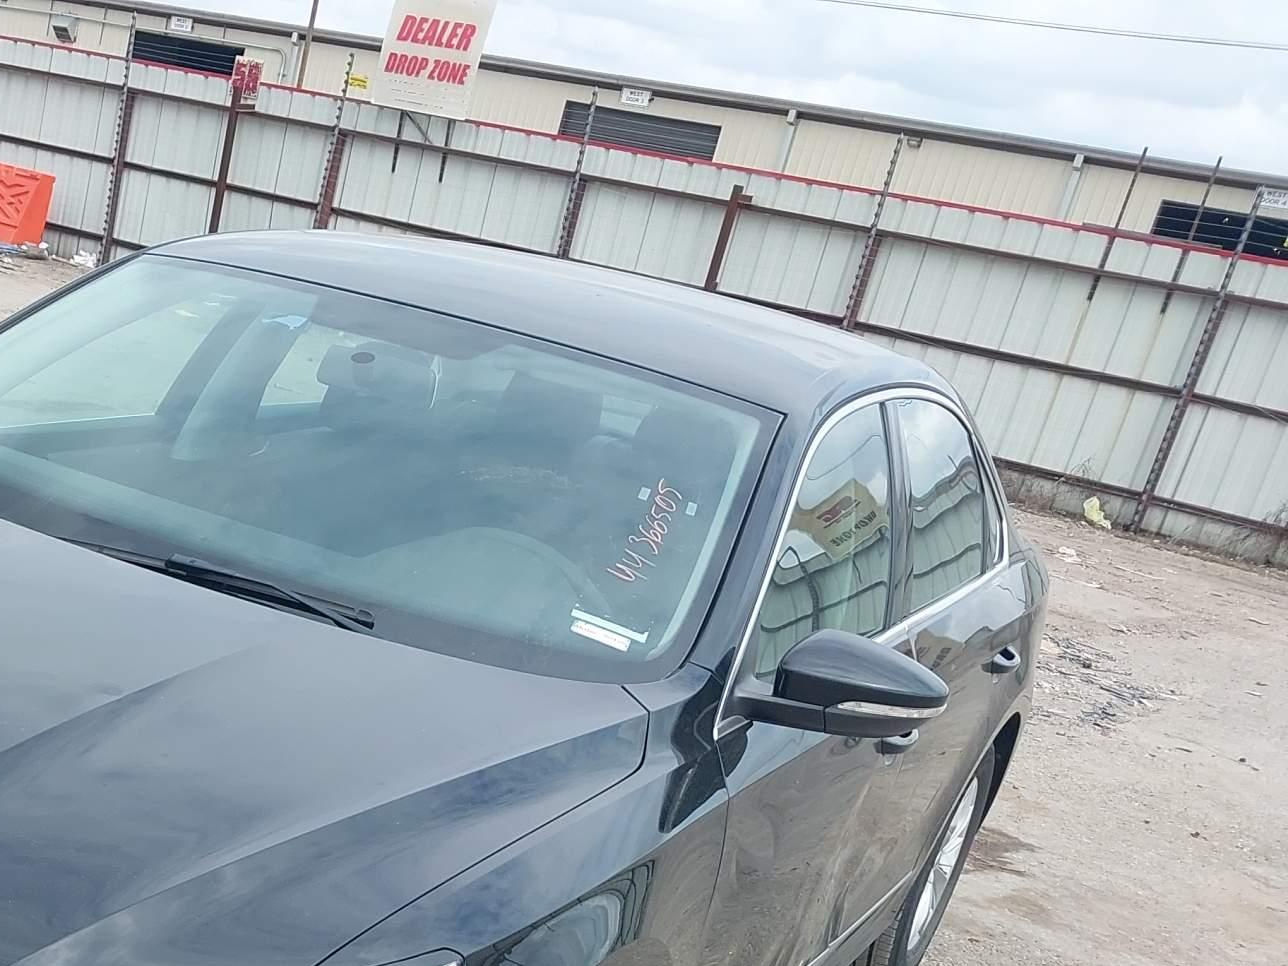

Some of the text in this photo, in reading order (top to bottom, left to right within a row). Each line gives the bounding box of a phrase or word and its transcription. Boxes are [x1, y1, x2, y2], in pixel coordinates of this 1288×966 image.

[396, 14, 477, 52] DEALER
[383, 52, 471, 86] DROP ZONE
[605, 477, 684, 582] 44366505
